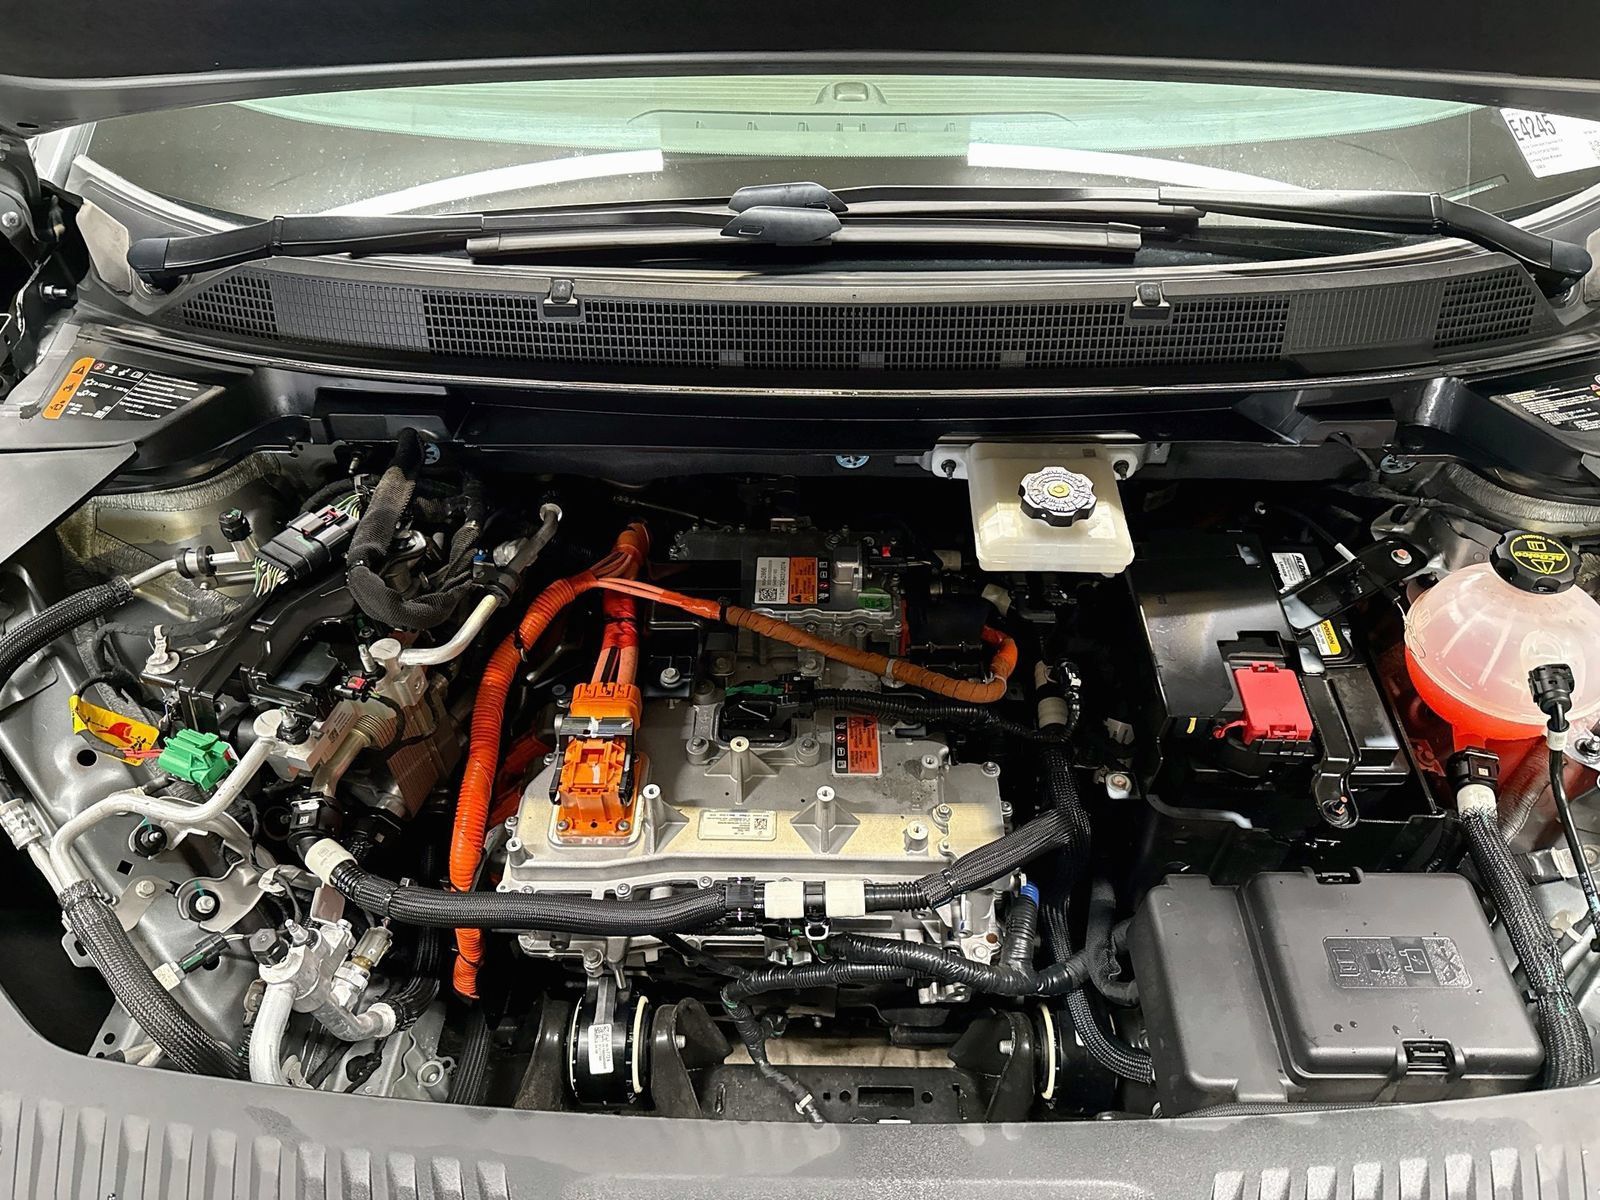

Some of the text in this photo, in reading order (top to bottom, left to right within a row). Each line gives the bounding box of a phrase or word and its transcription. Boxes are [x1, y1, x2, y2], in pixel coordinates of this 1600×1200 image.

[1508, 114, 1556, 141] E4245
[1514, 551, 1566, 561] ACDelco
[1323, 622, 1336, 645] POISON
